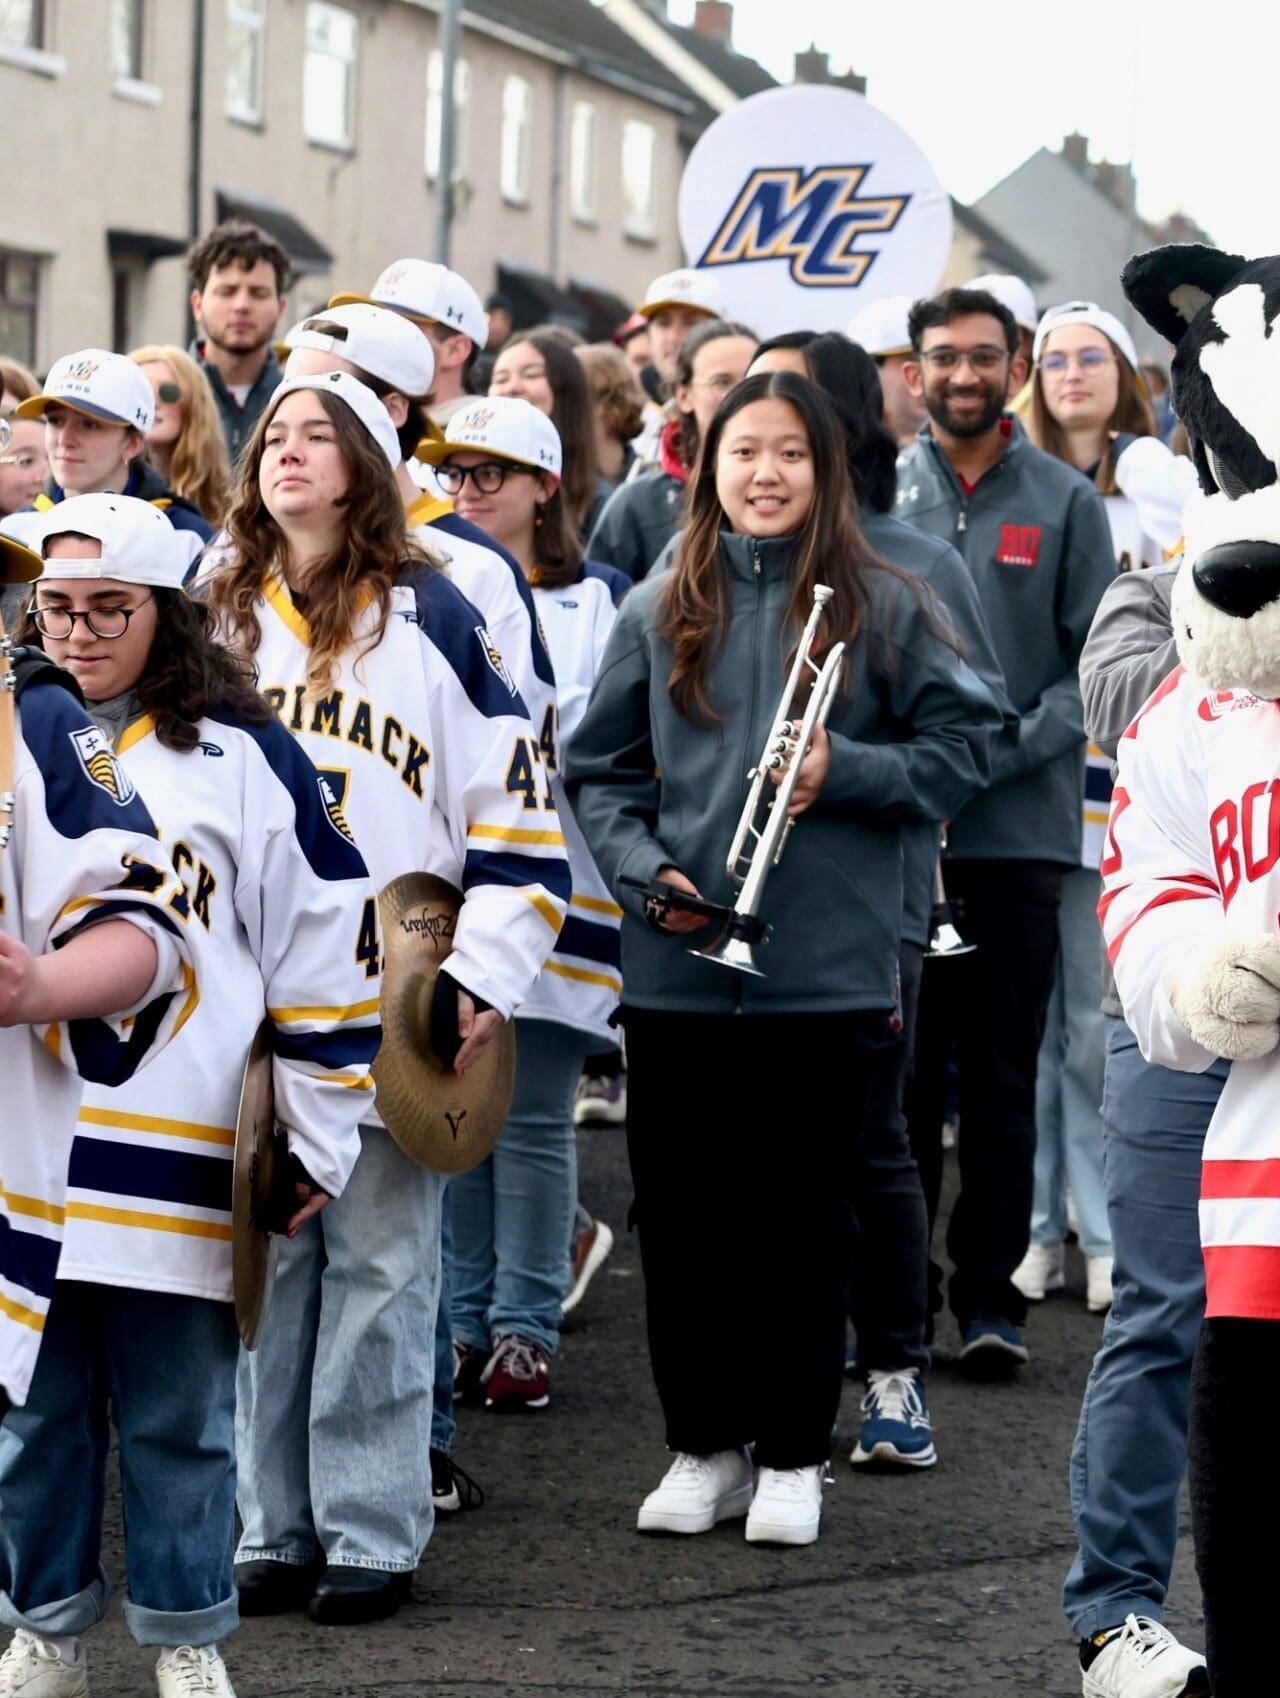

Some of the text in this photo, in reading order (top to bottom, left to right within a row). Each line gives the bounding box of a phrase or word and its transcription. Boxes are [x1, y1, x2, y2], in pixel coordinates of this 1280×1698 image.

[696, 163, 913, 288] MC
[997, 523, 1041, 568] BU
[400, 906, 455, 952] Zildjian
